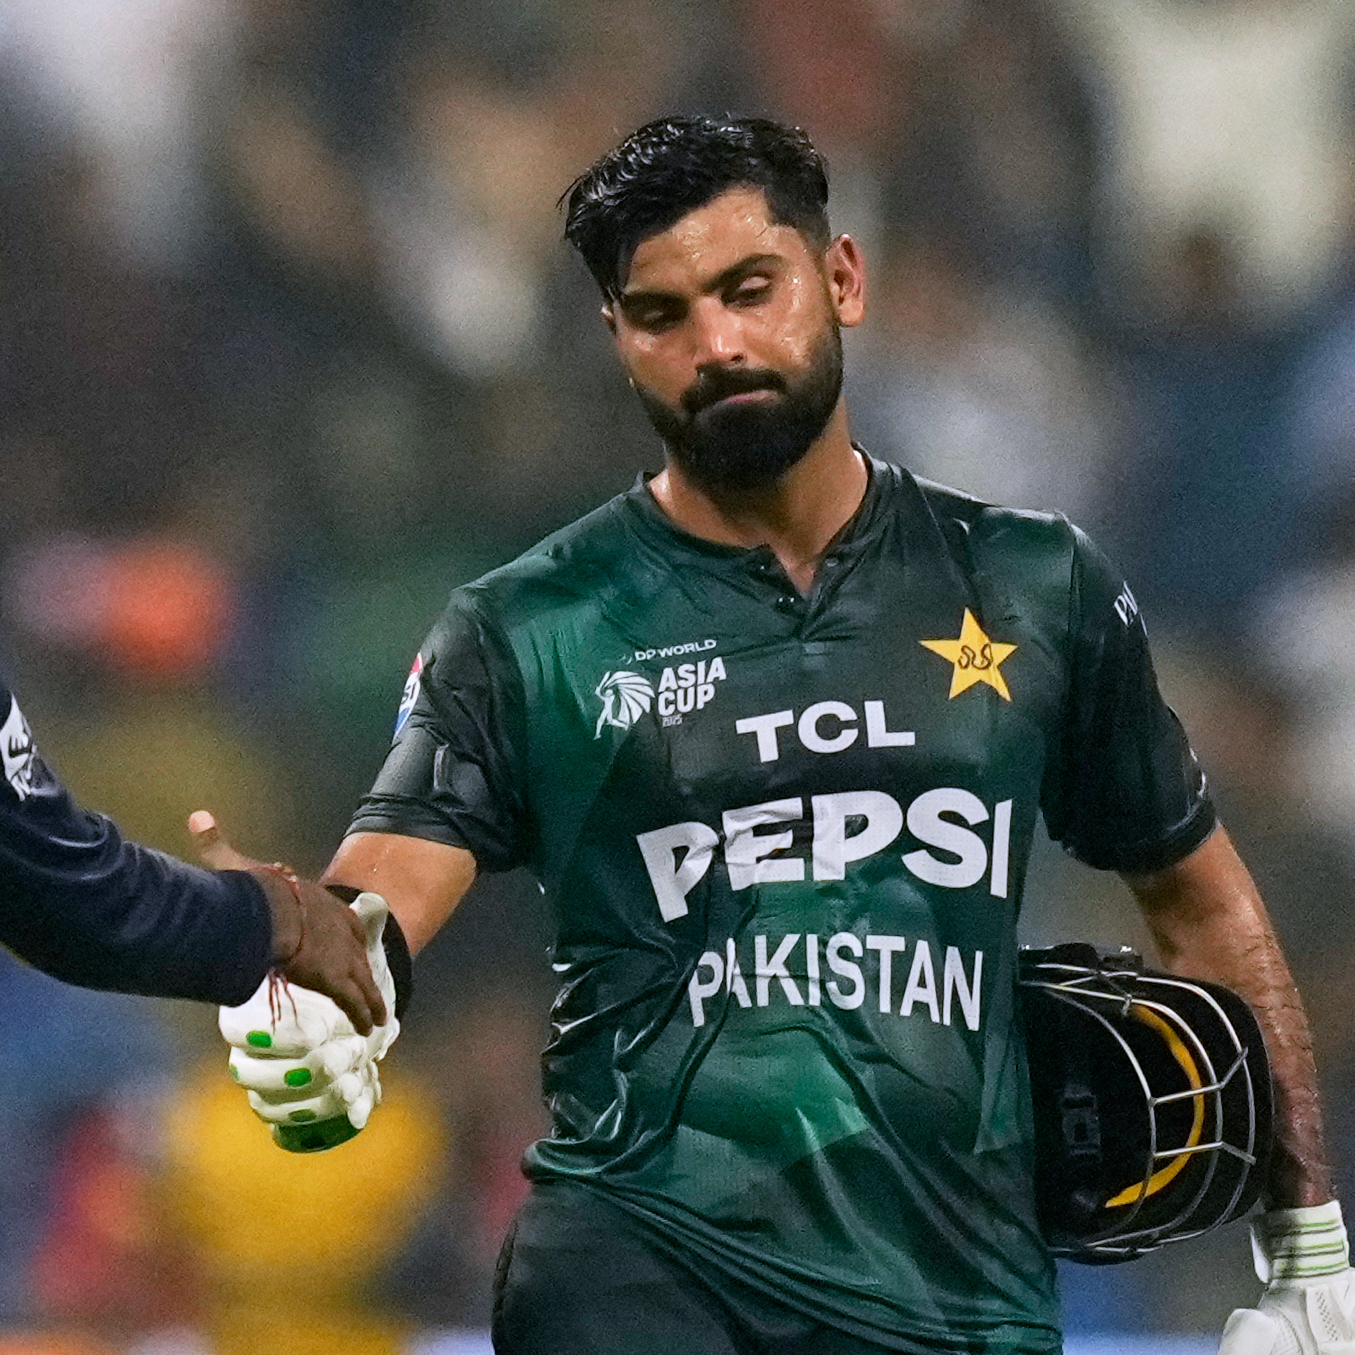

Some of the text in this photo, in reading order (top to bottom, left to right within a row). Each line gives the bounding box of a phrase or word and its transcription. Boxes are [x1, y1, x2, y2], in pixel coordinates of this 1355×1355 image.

[635, 639, 717, 662] DP WORLD
[658, 656, 727, 693] ASIA
[658, 683, 716, 717] CUP
[736, 700, 916, 762] TCL
[637, 787, 1013, 922] PEPSI
[687, 931, 984, 1031] PAKISTAN
